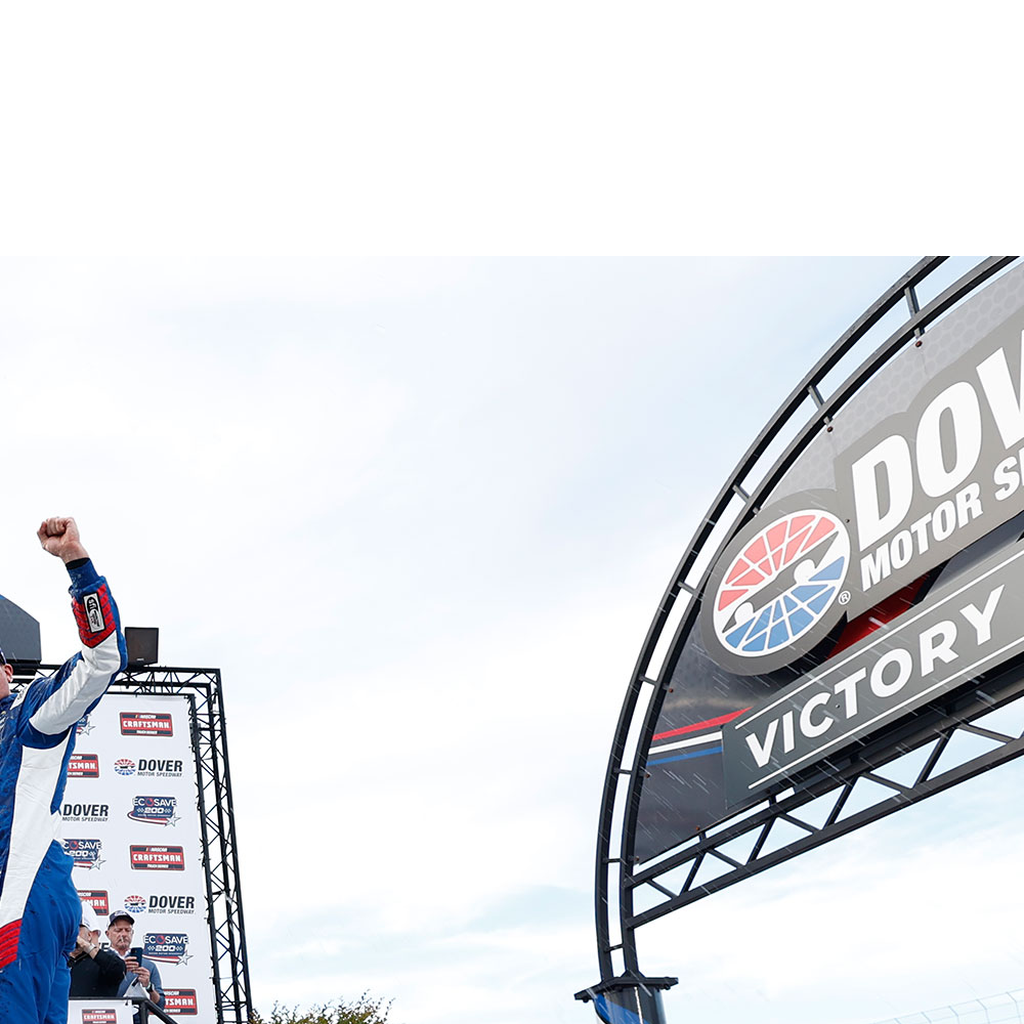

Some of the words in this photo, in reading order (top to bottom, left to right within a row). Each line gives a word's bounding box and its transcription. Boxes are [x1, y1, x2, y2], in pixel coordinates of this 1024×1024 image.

[852, 330, 1024, 551] DOV
[860, 477, 984, 591] MOTOR
[746, 585, 1005, 768] VICTORY
[123, 721, 171, 729] CRAFTSMAN
[68, 762, 97, 770] TSMAN
[138, 759, 183, 772] DOVER
[132, 797, 176, 807] ECOSAVE
[63, 804, 109, 817] DOVER
[132, 854, 182, 862] CRAFTSMAN
[149, 896, 195, 909] DOVER
[144, 935, 189, 944] ECOSAVE
[165, 998, 194, 1006] TSMAN
